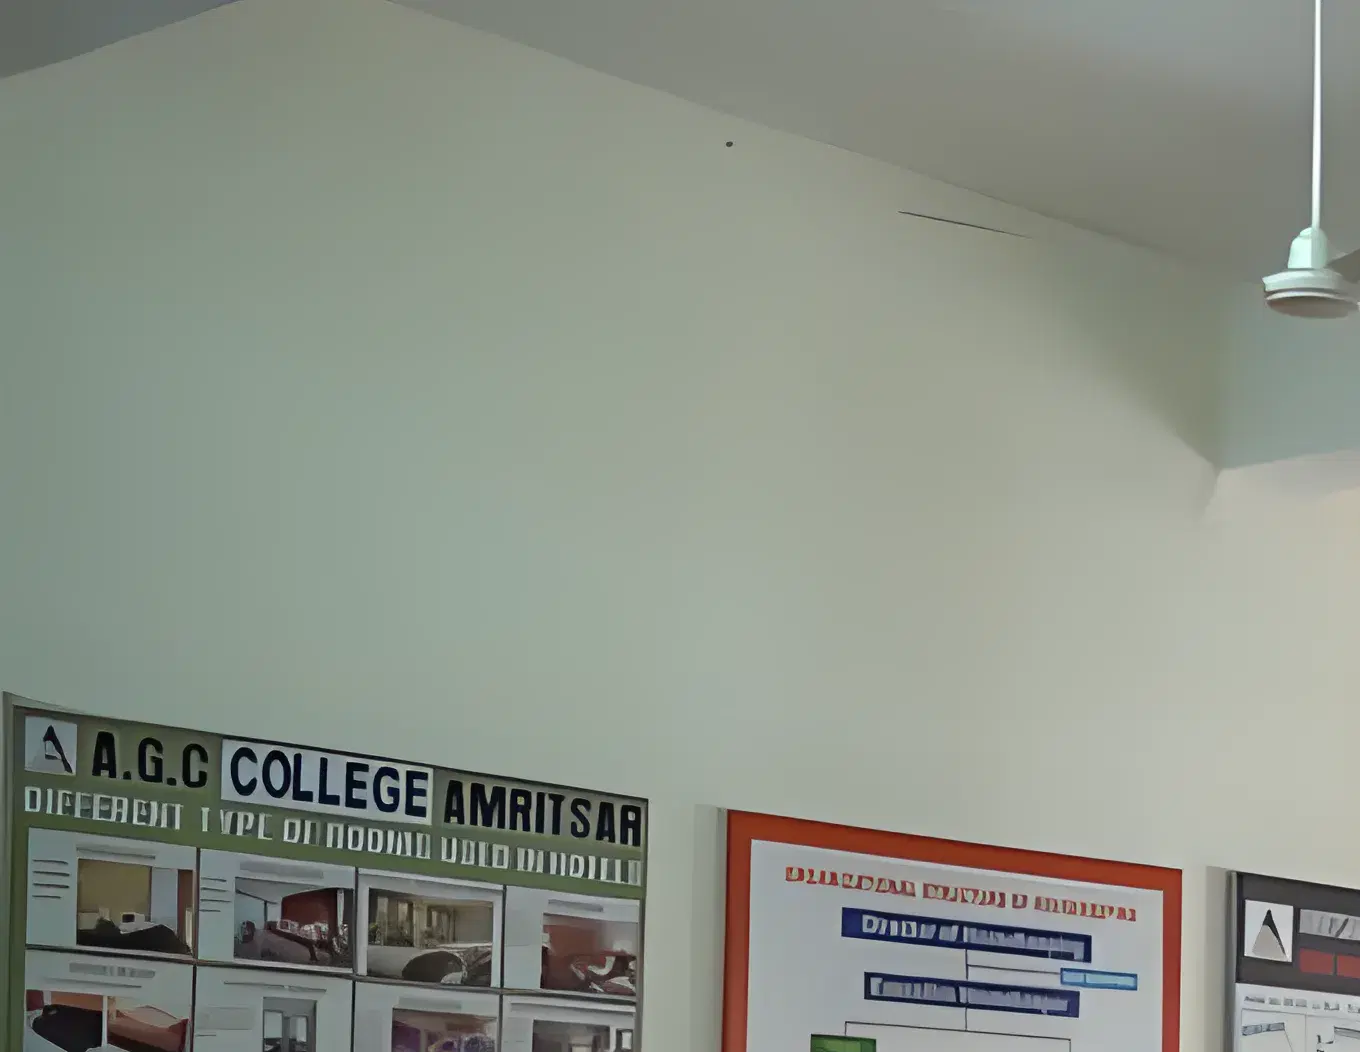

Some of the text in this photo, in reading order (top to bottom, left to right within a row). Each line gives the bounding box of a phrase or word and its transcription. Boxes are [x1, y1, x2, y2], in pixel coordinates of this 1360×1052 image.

[92, 730, 643, 847] A.G.C COLLEGE AMRITSAR
